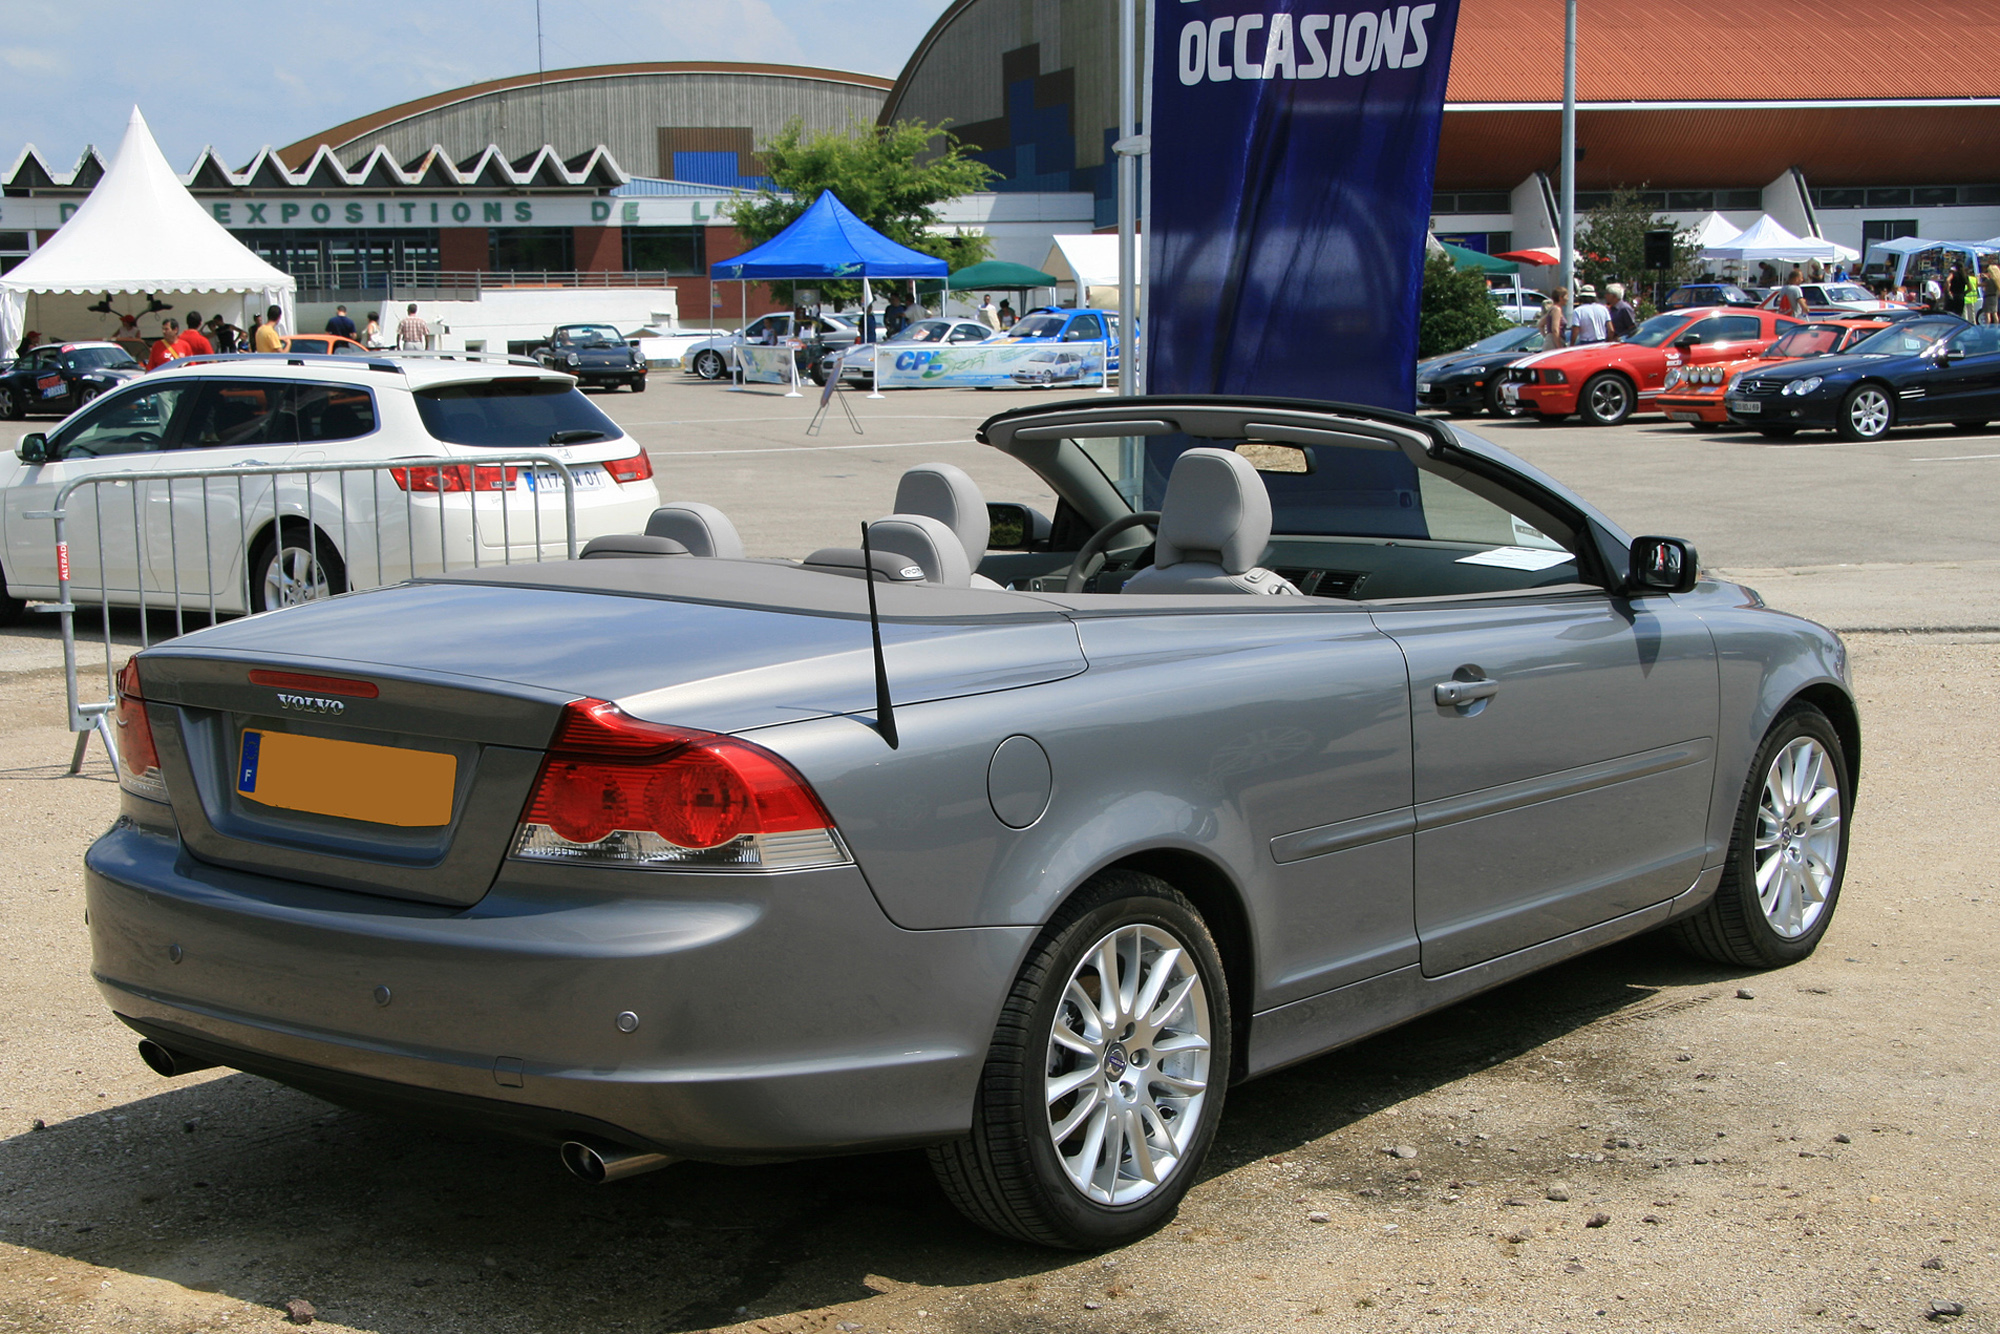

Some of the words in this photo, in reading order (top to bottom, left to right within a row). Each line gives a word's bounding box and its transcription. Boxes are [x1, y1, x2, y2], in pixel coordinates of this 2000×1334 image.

[1179, 3, 1436, 86] OCCASIONS
[213, 202, 533, 225] EXPOSITIONS
[591, 201, 640, 221] DE
[537, 472, 567, 490] 117
[584, 470, 601, 486] 01
[60, 545, 68, 580] ALTRAD
[277, 693, 345, 716] VOLVO
[244, 769, 252, 782] F
